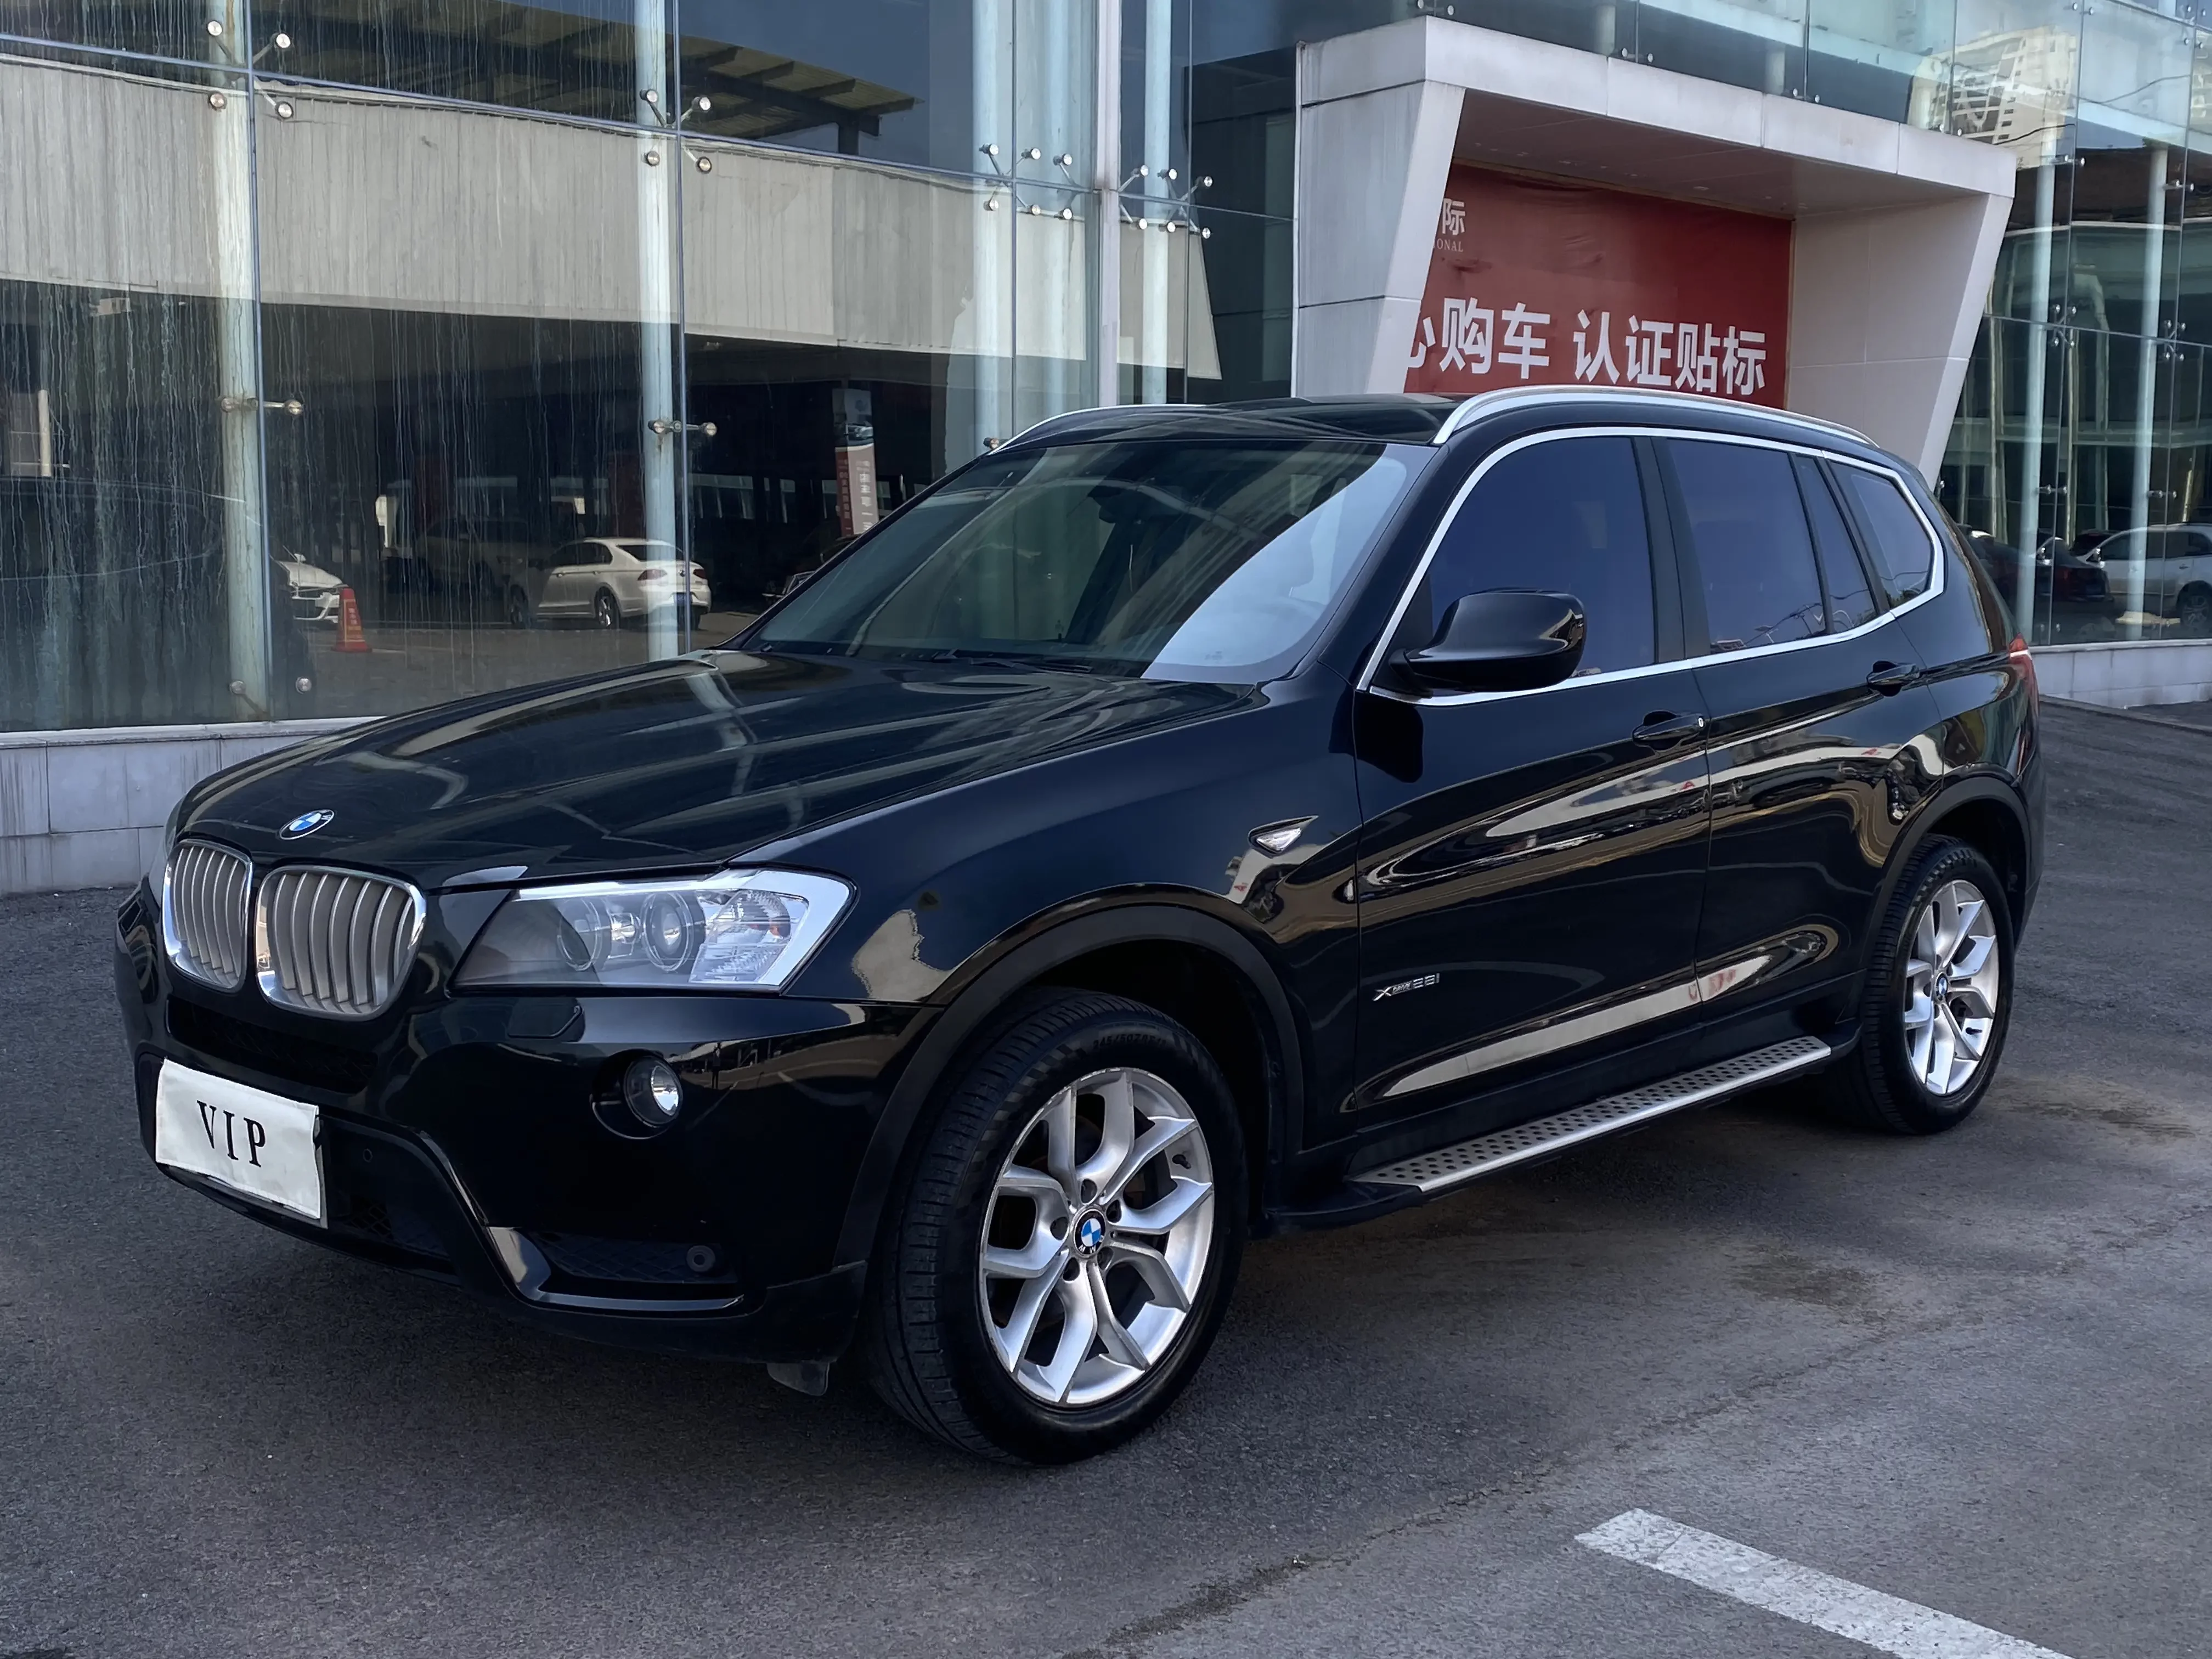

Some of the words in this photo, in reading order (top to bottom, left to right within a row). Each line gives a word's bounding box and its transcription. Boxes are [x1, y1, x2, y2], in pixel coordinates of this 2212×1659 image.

[1442, 198, 1466, 235] 际
[1572, 309, 1767, 395] 认证贴标
[196, 1099, 266, 1168] VIP
